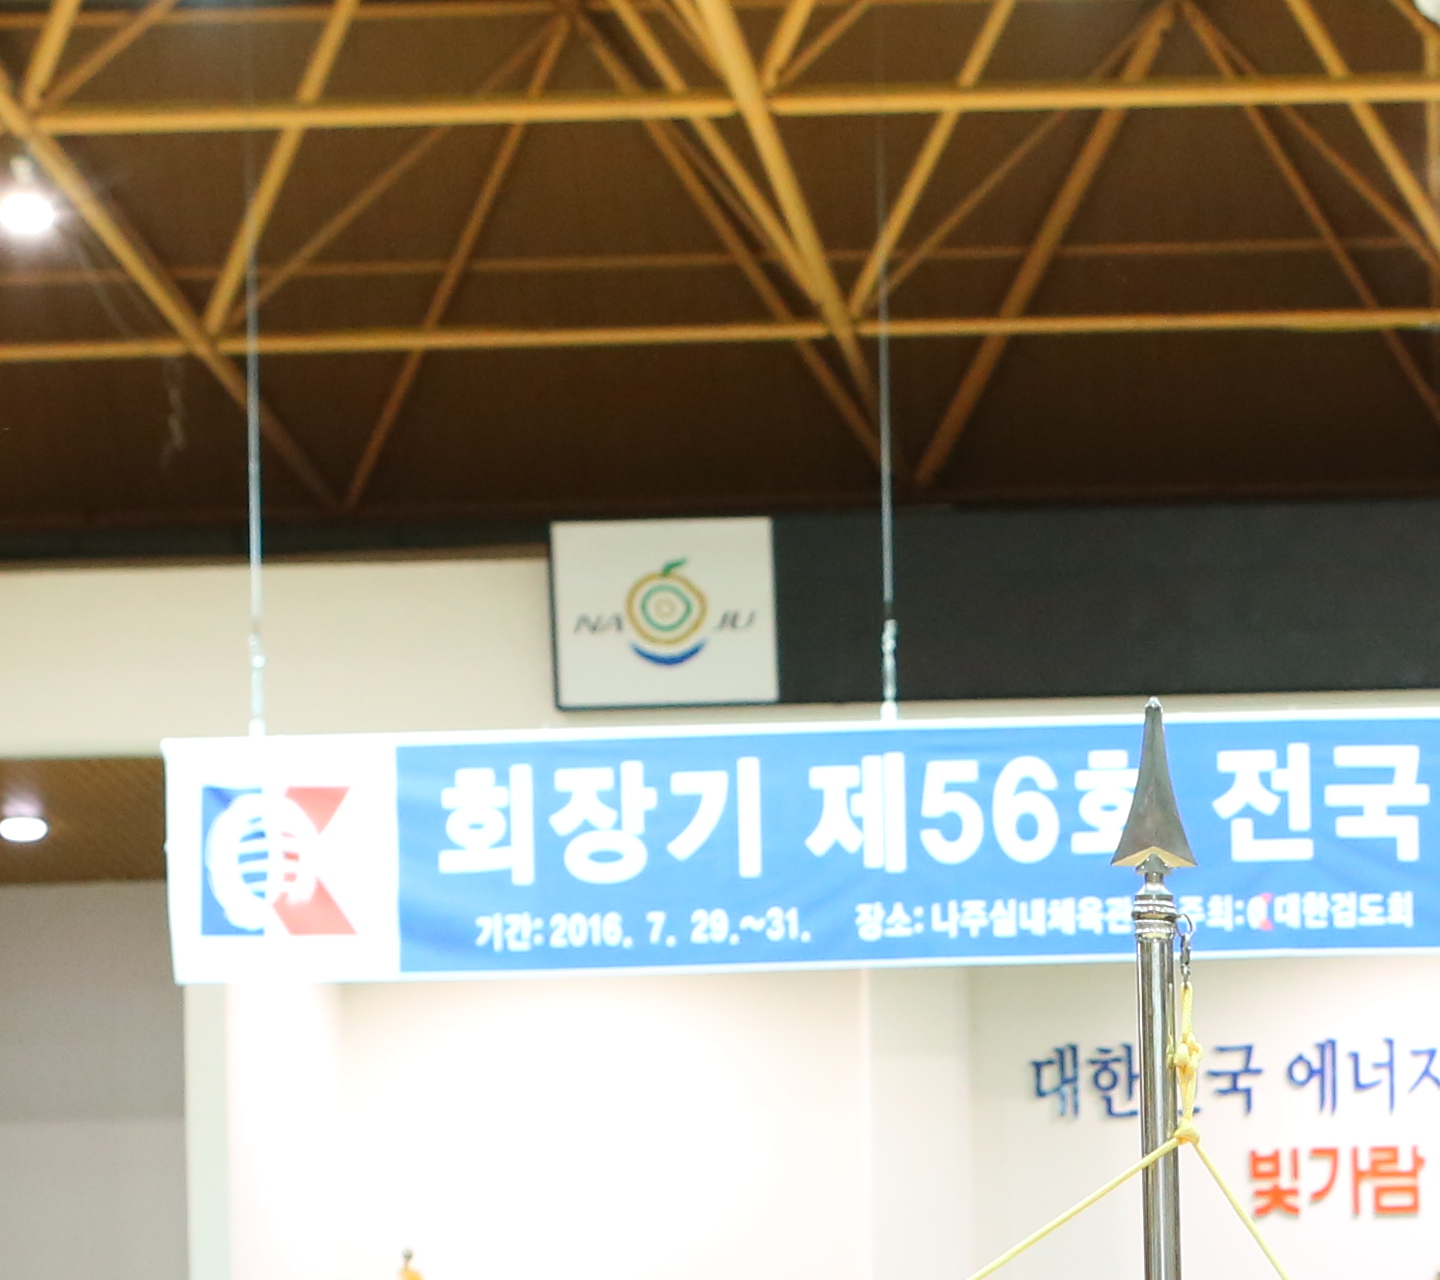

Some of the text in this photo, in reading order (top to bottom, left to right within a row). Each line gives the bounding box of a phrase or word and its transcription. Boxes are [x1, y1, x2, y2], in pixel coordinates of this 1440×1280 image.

[438, 757, 762, 886] 회장기
[1030, 1040, 1264, 1118] 대한국
[1247, 1146, 1426, 1219] 빛가람
